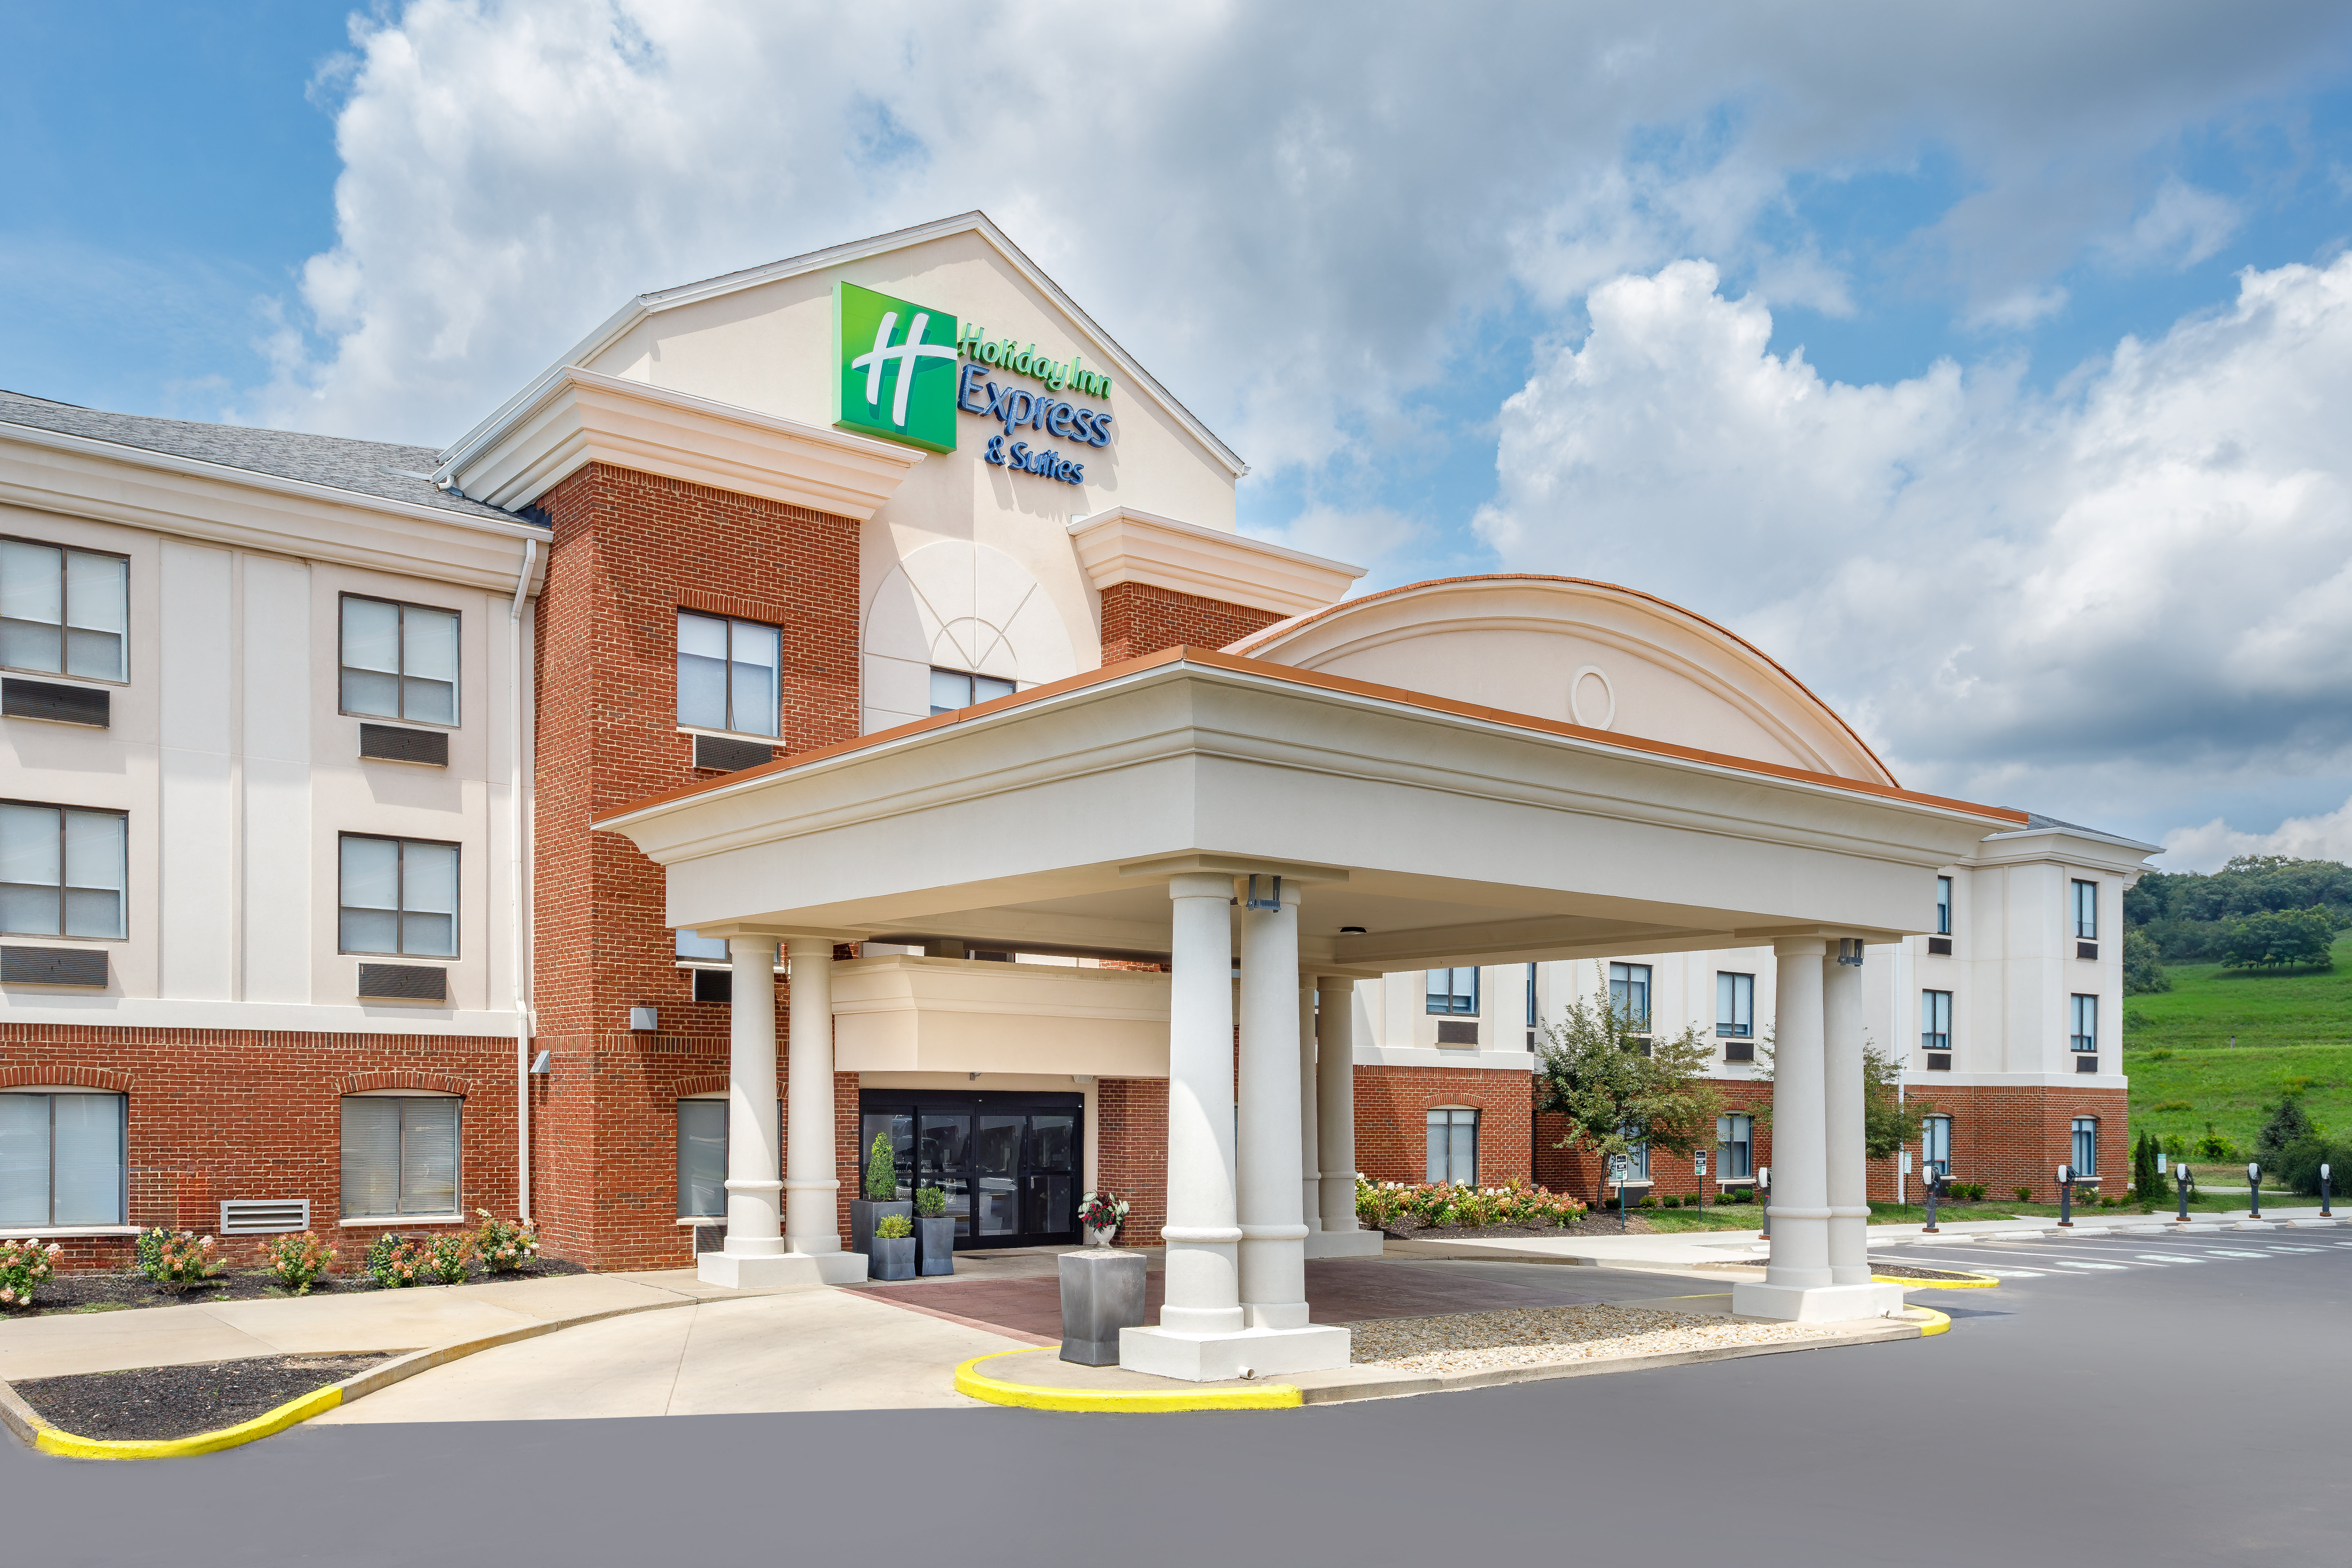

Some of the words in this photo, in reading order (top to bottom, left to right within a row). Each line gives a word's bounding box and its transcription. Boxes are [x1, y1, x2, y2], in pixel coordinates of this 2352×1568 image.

[957, 323, 1068, 392] Holiday
[1067, 356, 1112, 400] Inn
[957, 364, 1112, 448] Express
[984, 435, 1006, 467] &
[1008, 442, 1085, 486] Suites
